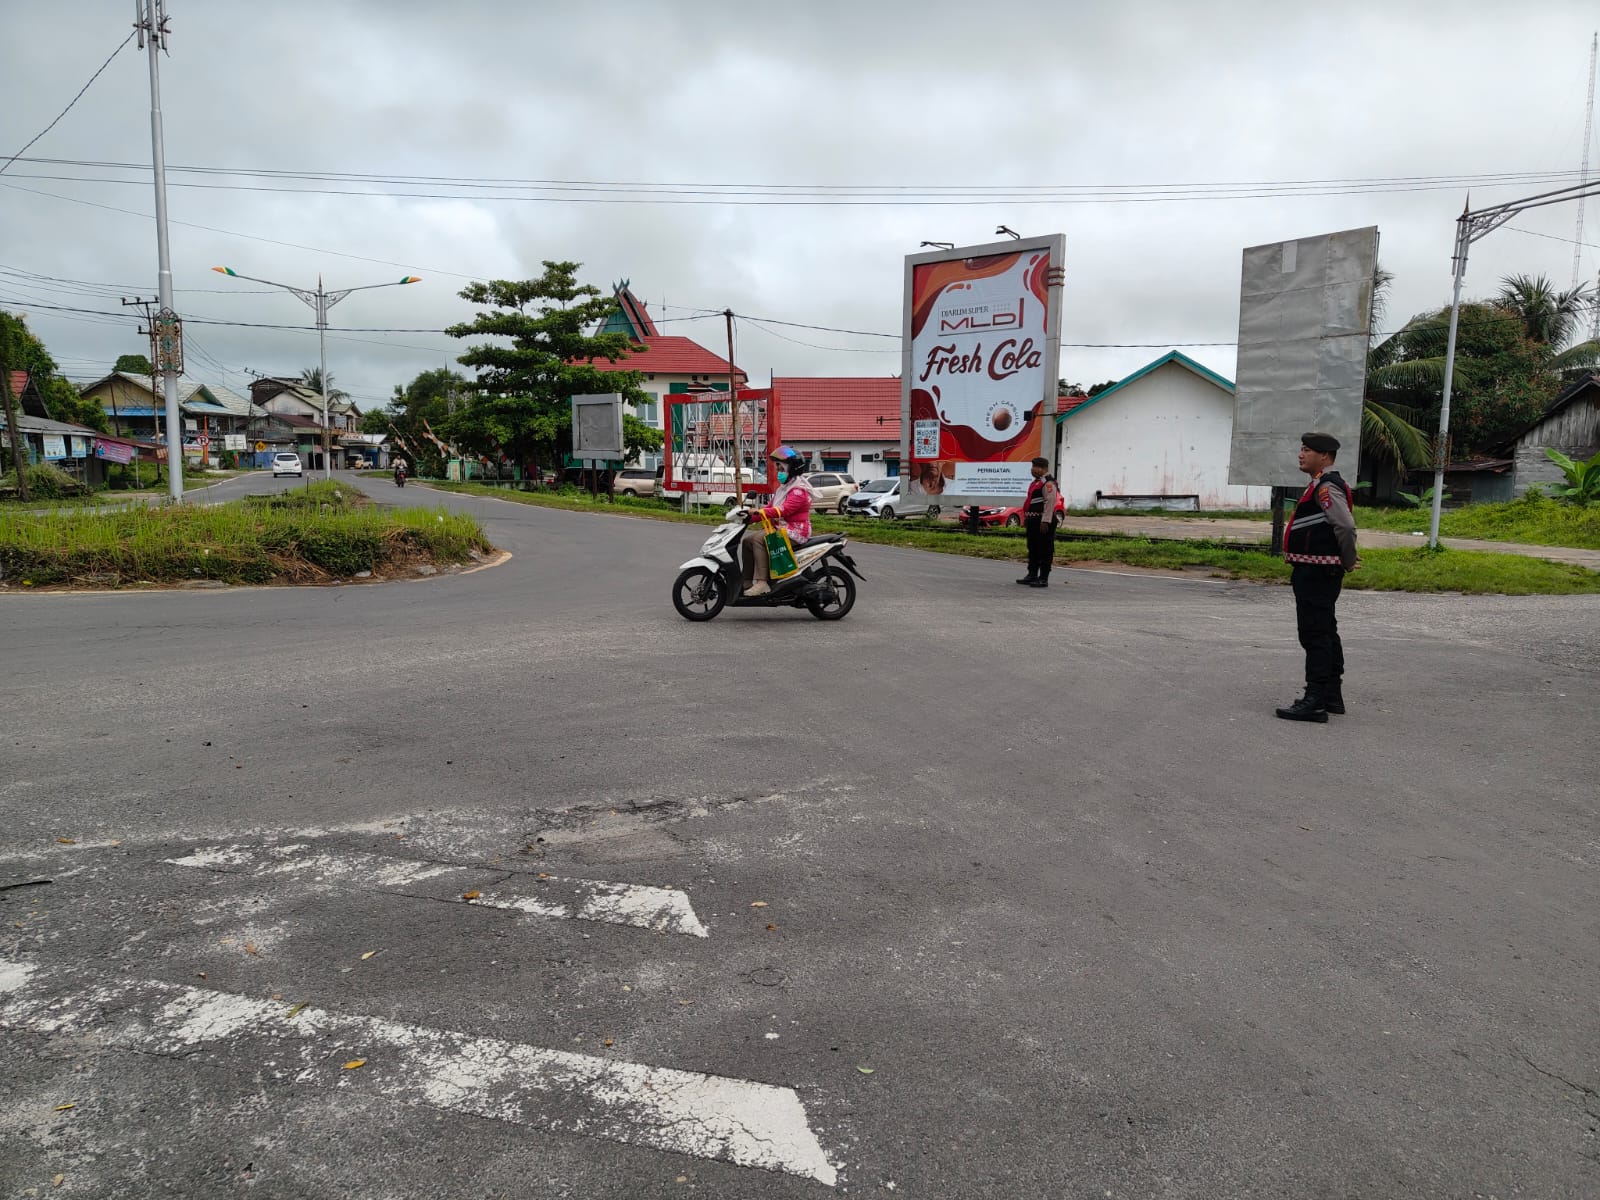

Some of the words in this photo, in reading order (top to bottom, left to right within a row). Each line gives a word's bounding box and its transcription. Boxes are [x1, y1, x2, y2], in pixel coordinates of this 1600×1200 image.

[968, 305, 989, 314] SUPER
[919, 342, 982, 382] Fresh
[987, 338, 1041, 381] Cola
